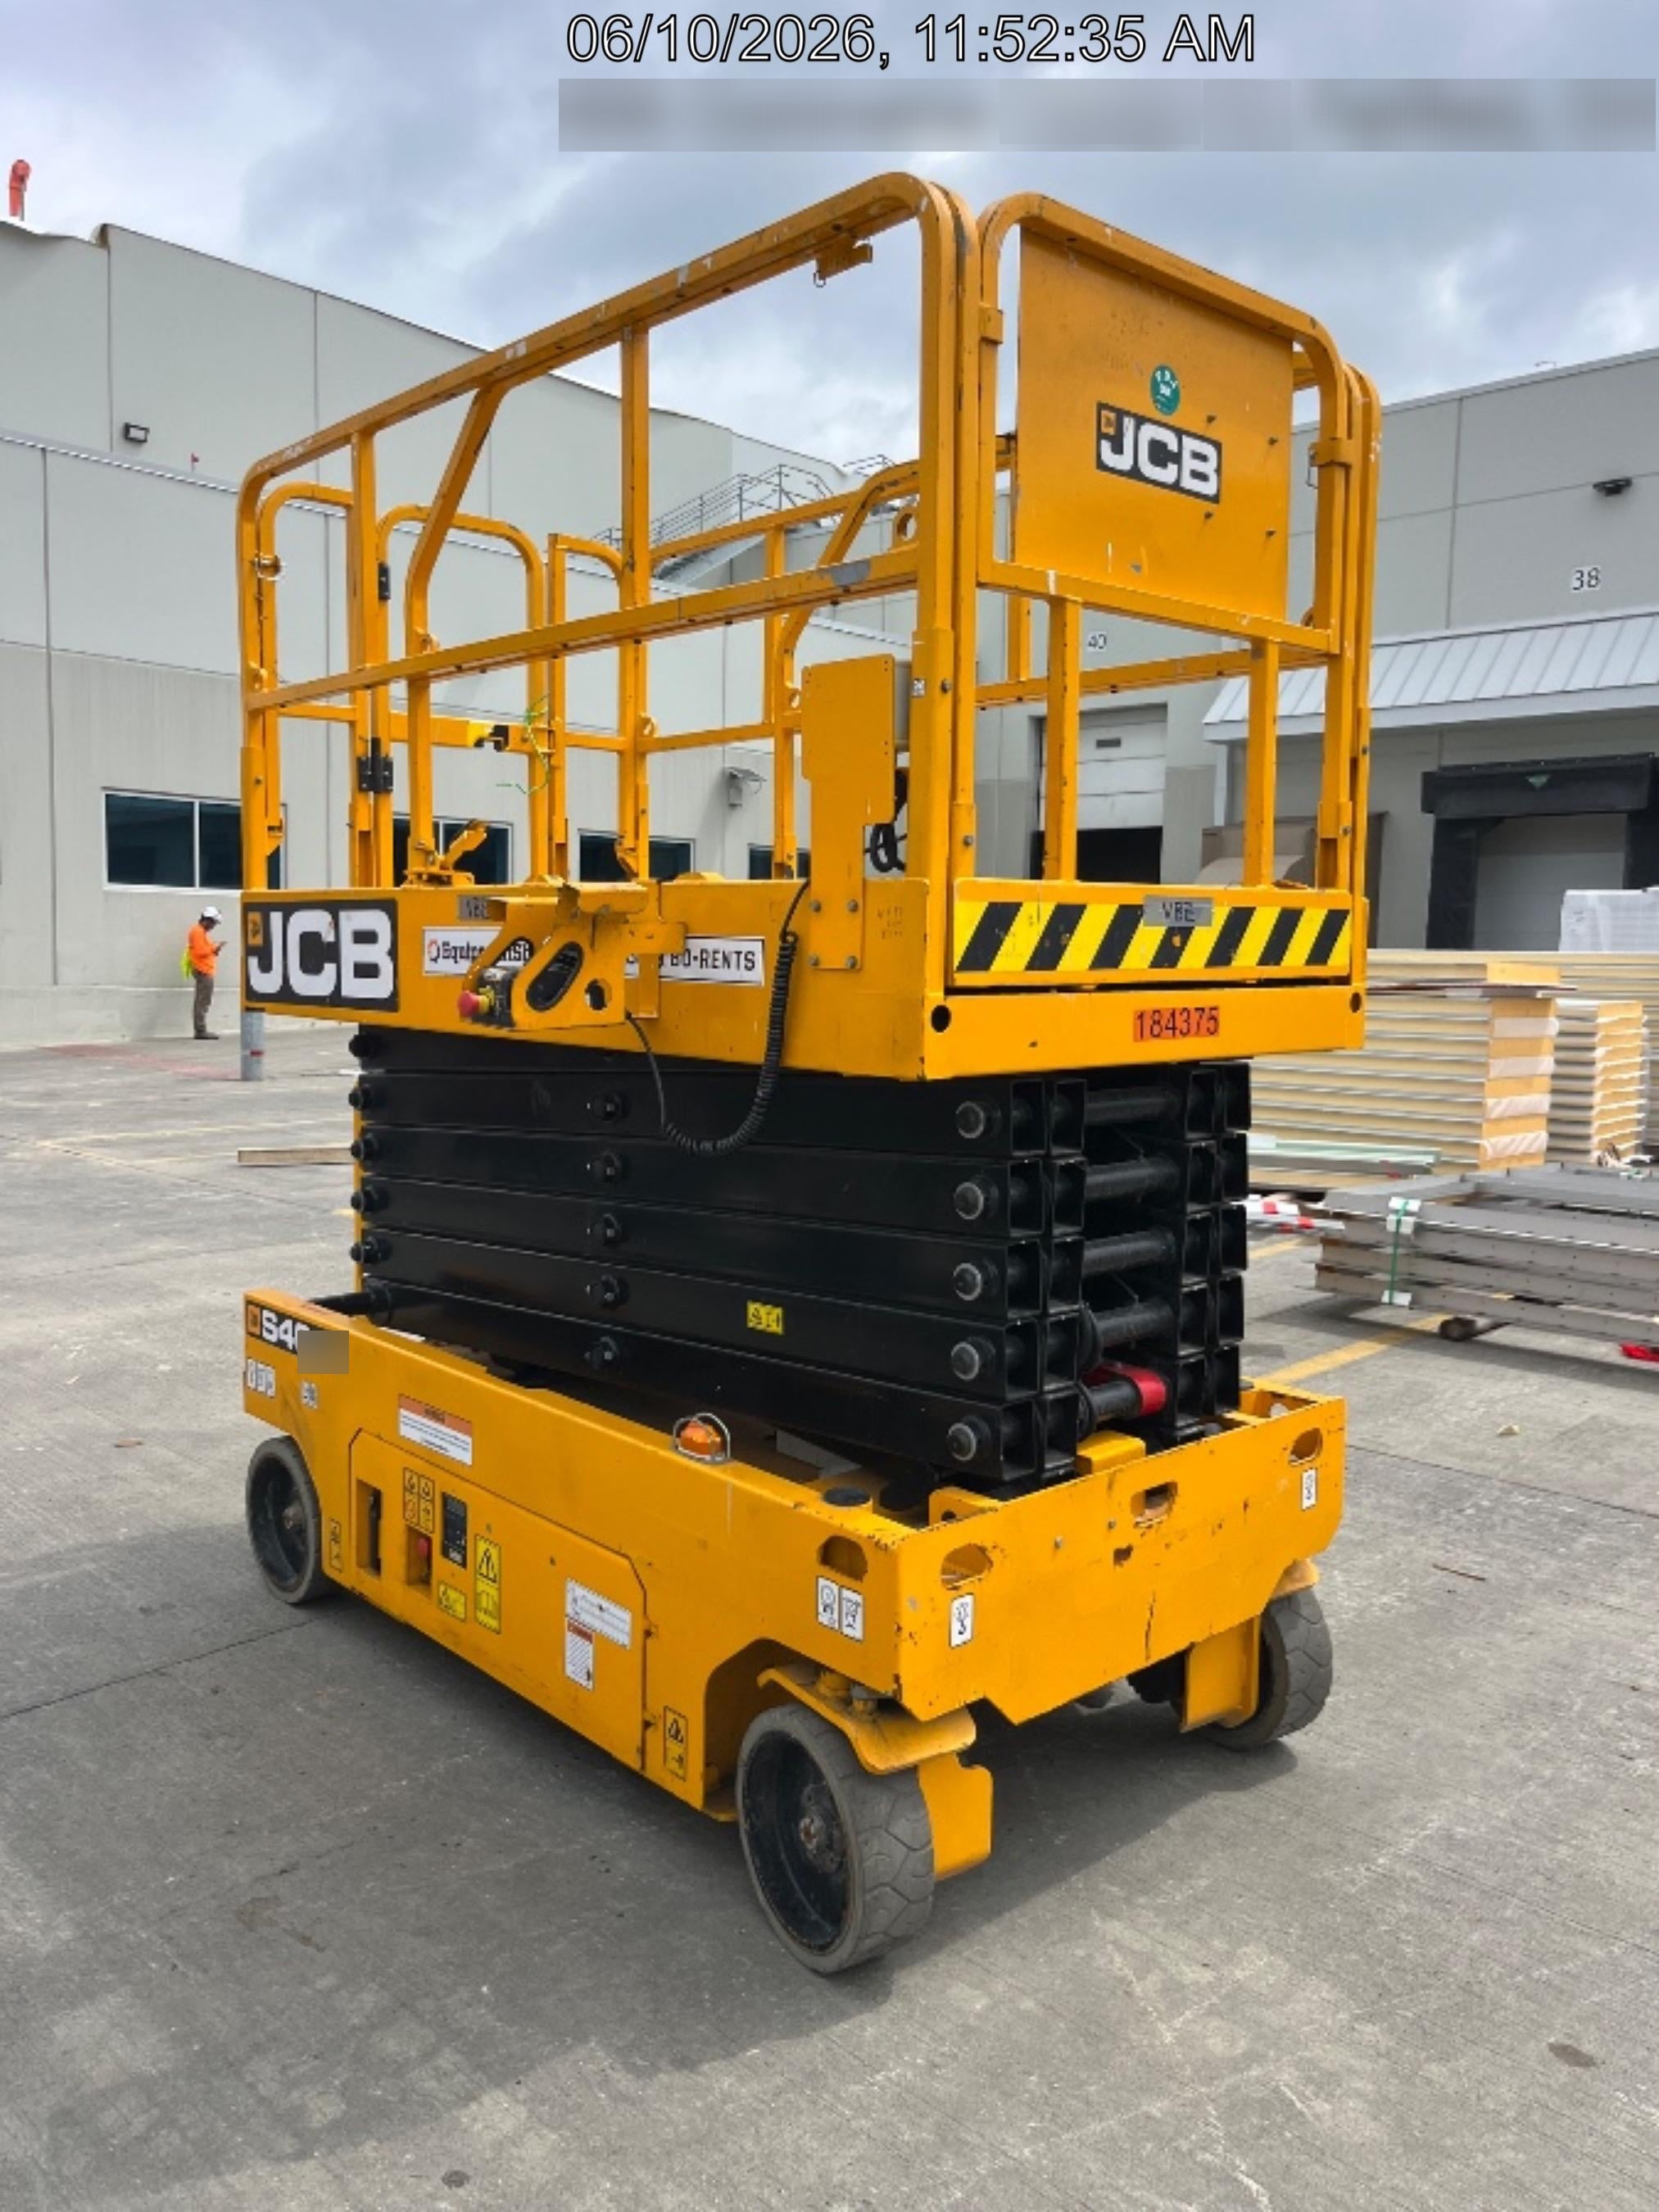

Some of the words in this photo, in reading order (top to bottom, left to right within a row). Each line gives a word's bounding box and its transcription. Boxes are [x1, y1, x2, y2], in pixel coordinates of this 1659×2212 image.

[1100, 415, 1218, 496] JCB
[1572, 567, 1599, 591] 38
[247, 909, 394, 999] JCB
[1136, 1007, 1220, 1040] 184375
